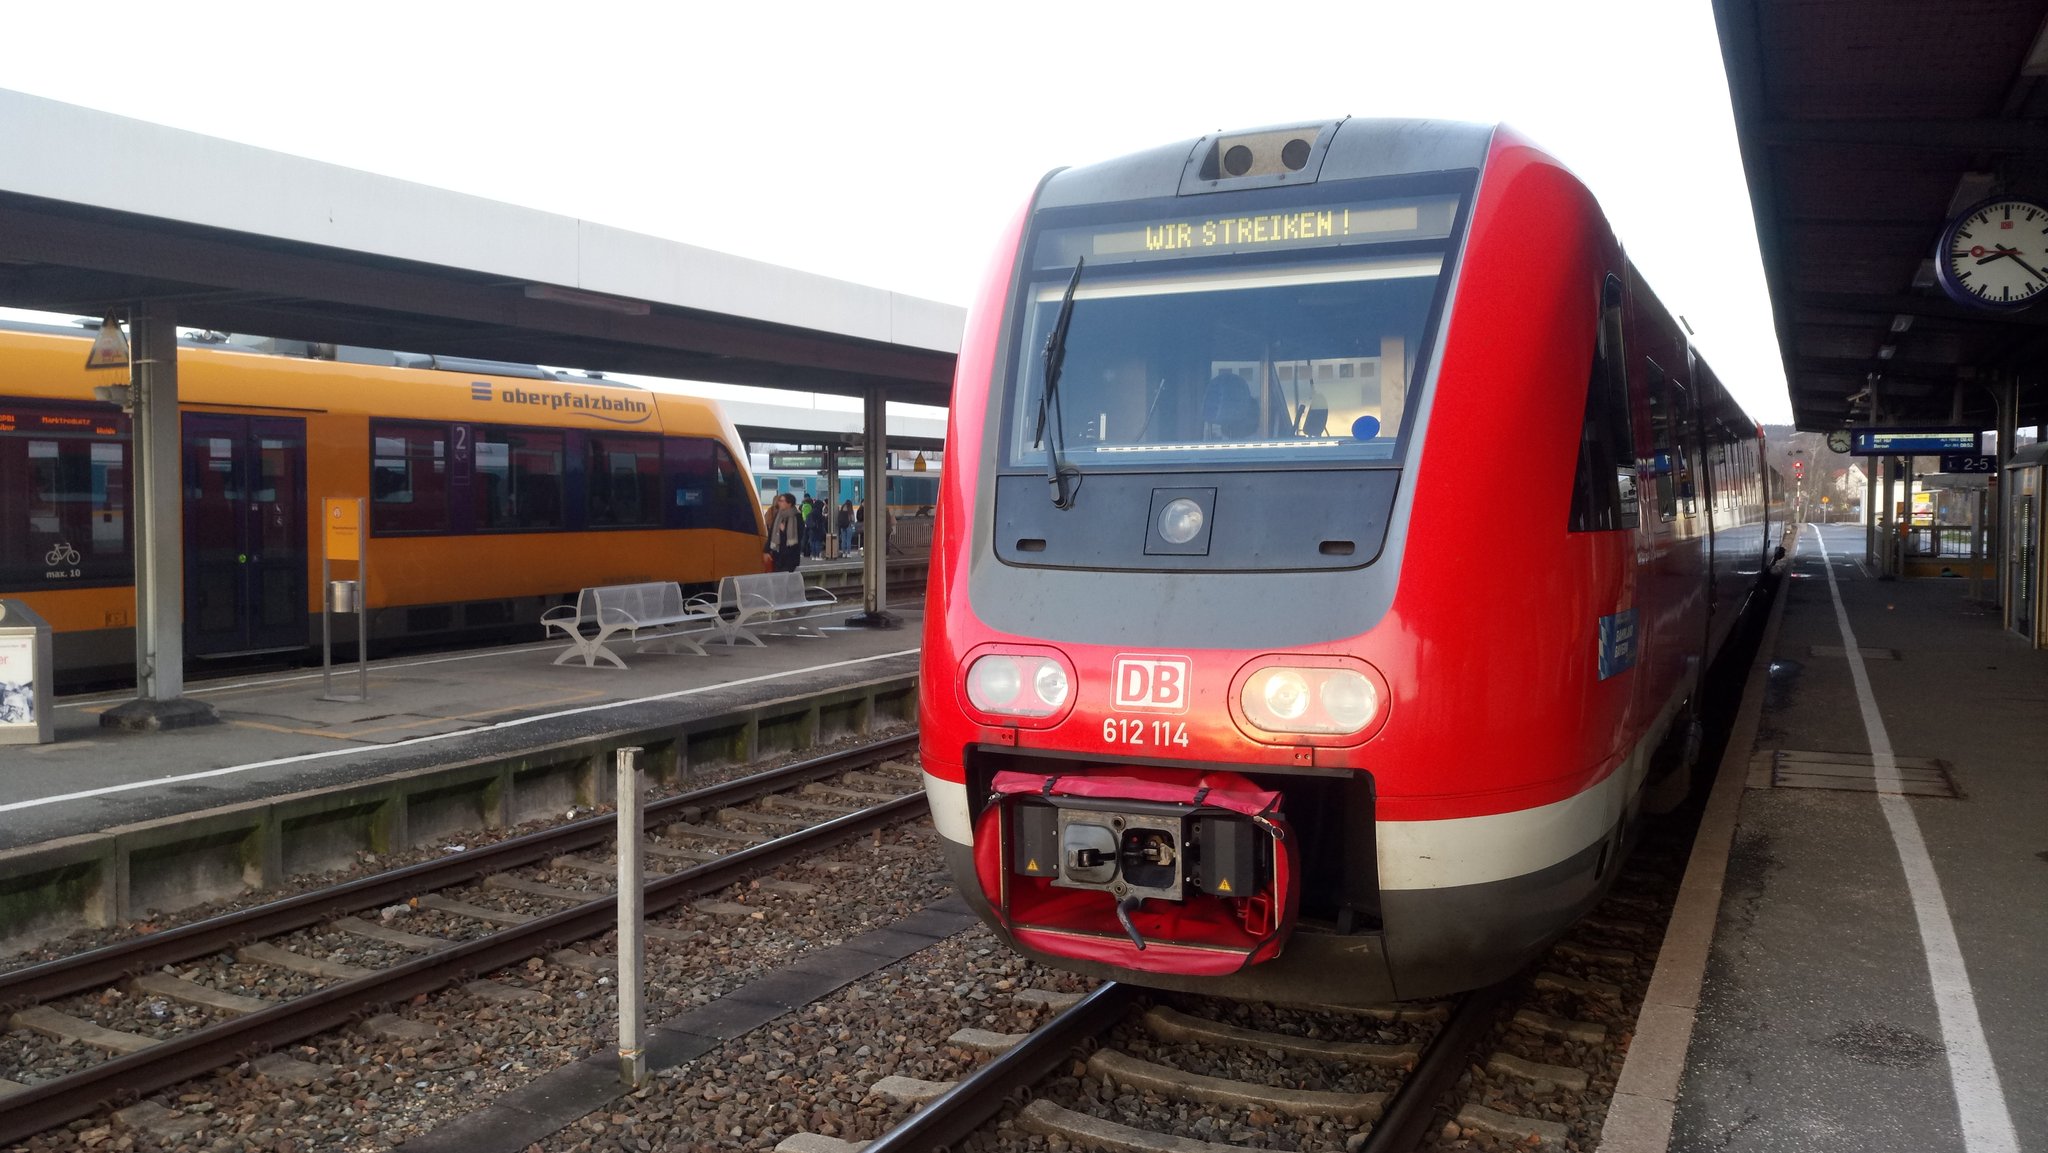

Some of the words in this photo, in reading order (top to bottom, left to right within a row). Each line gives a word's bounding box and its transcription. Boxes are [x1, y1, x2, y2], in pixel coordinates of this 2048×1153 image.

[1146, 223, 1192, 251] WIR
[1202, 211, 1332, 247] STREIKEN
[1343, 209, 1351, 235] !
[502, 387, 648, 413] oberpfalzbahn
[455, 426, 467, 450] 2
[1858, 434, 1866, 446] 1
[1964, 457, 1989, 470] 2-5
[46, 569, 68, 579] max.
[70, 568, 81, 578] 10
[1121, 663, 1180, 704] DB
[1102, 717, 1145, 746] 612
[1152, 720, 1190, 748] 114
